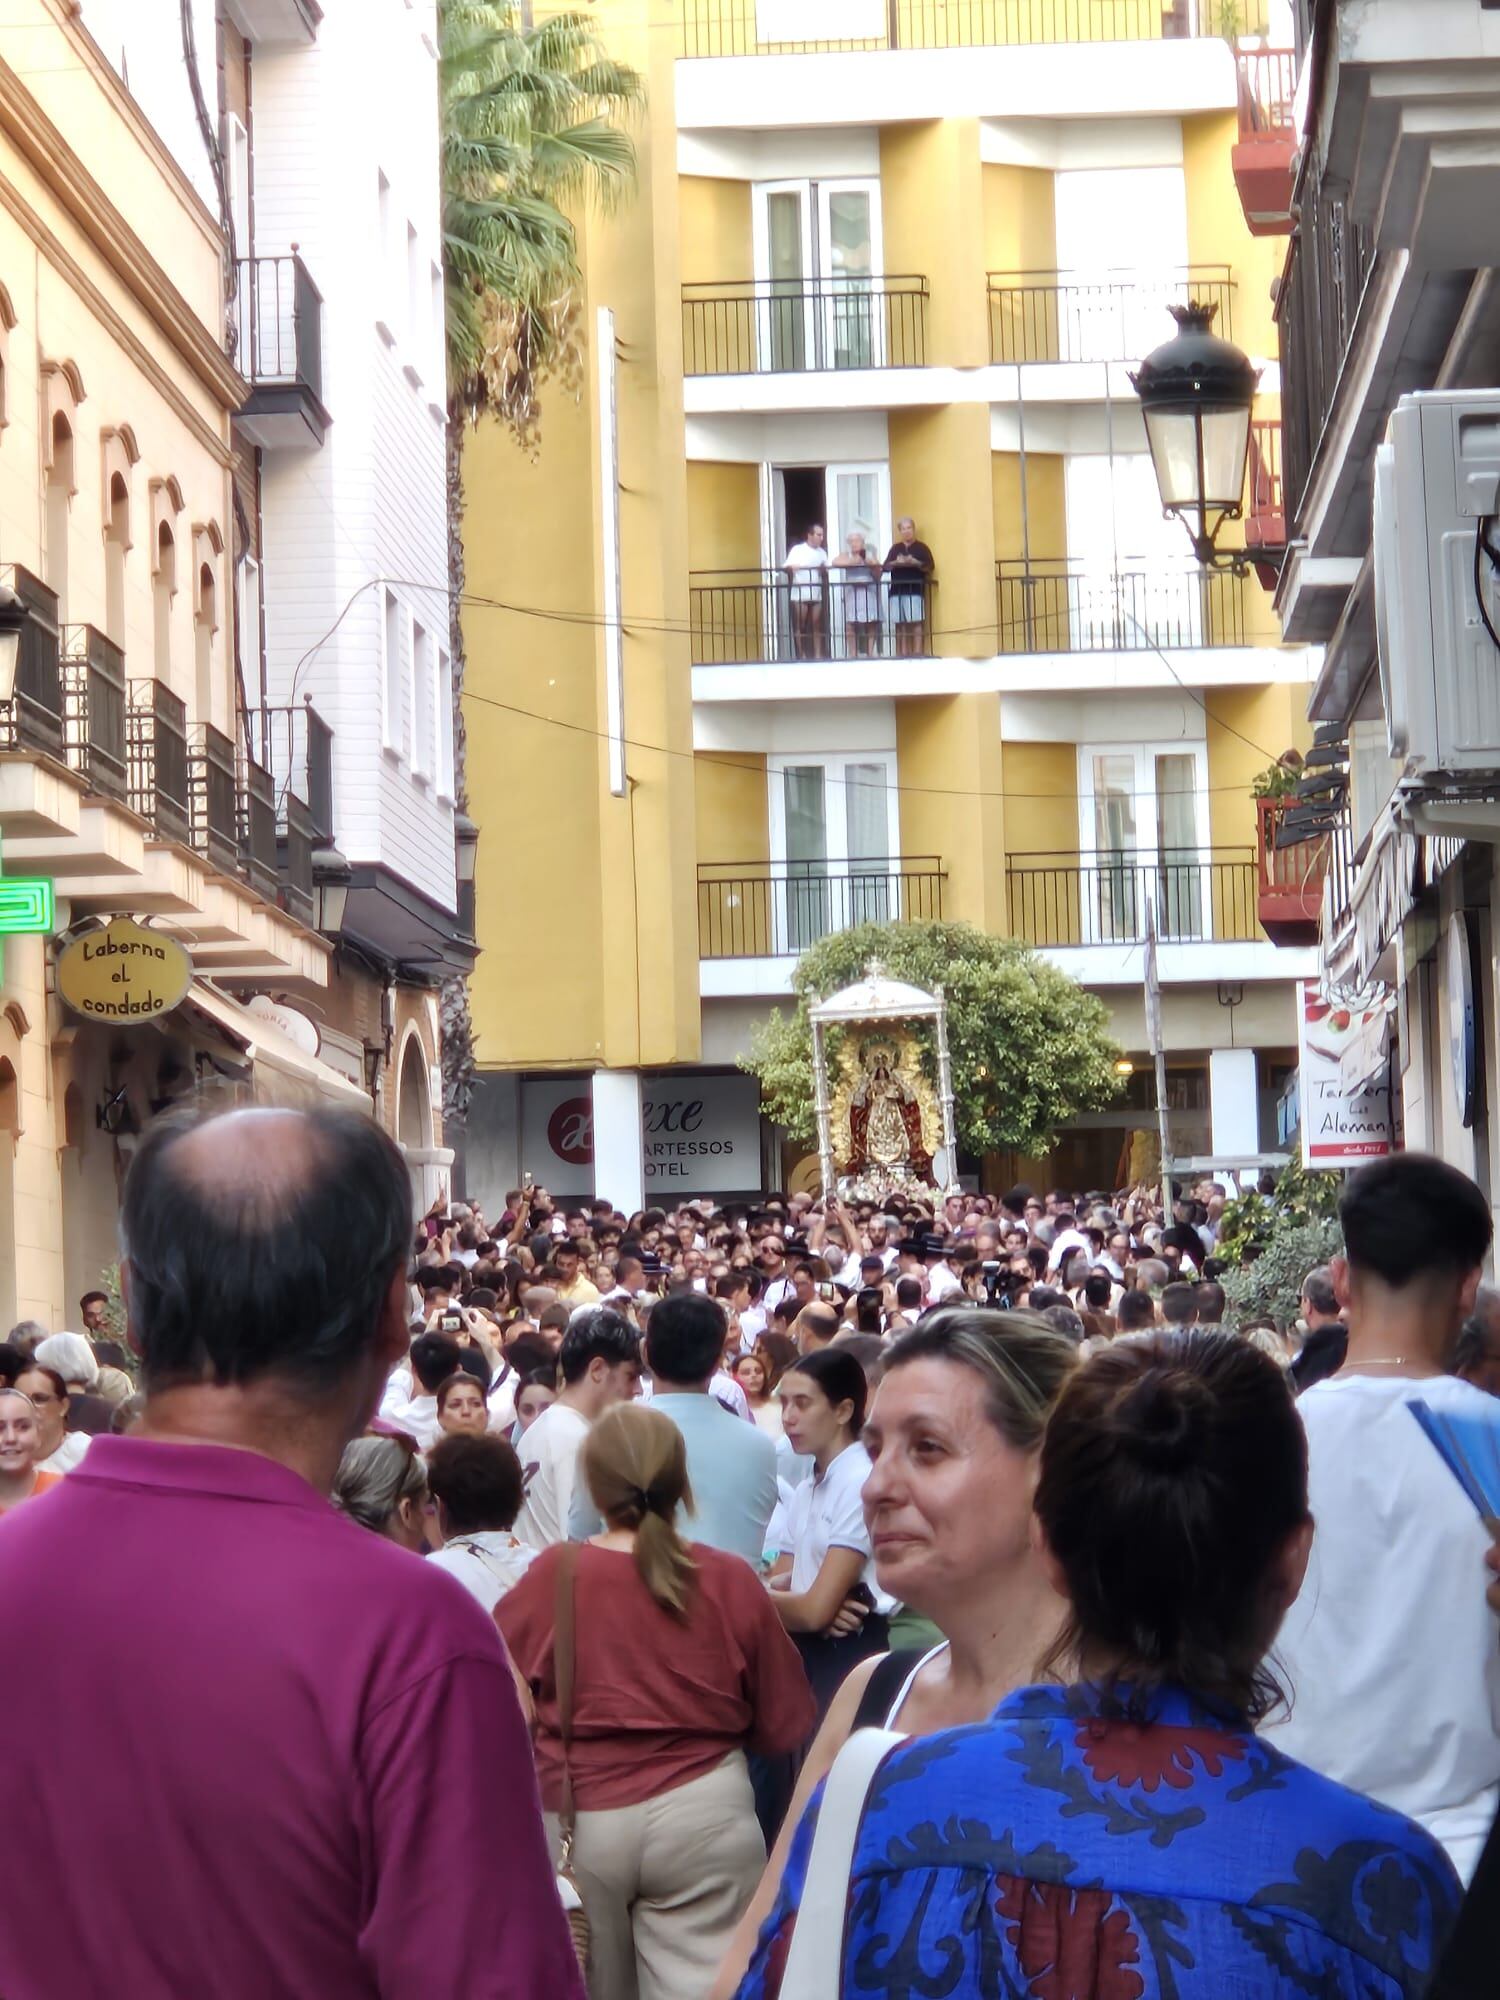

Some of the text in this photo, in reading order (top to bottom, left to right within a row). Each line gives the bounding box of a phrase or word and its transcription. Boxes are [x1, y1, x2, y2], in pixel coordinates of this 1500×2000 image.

[83, 989, 164, 1015] condado
[1320, 1111, 1402, 1134] Alemans
[644, 1140, 734, 1157] ARTESSOS
[643, 1162, 690, 1177] OTEL
